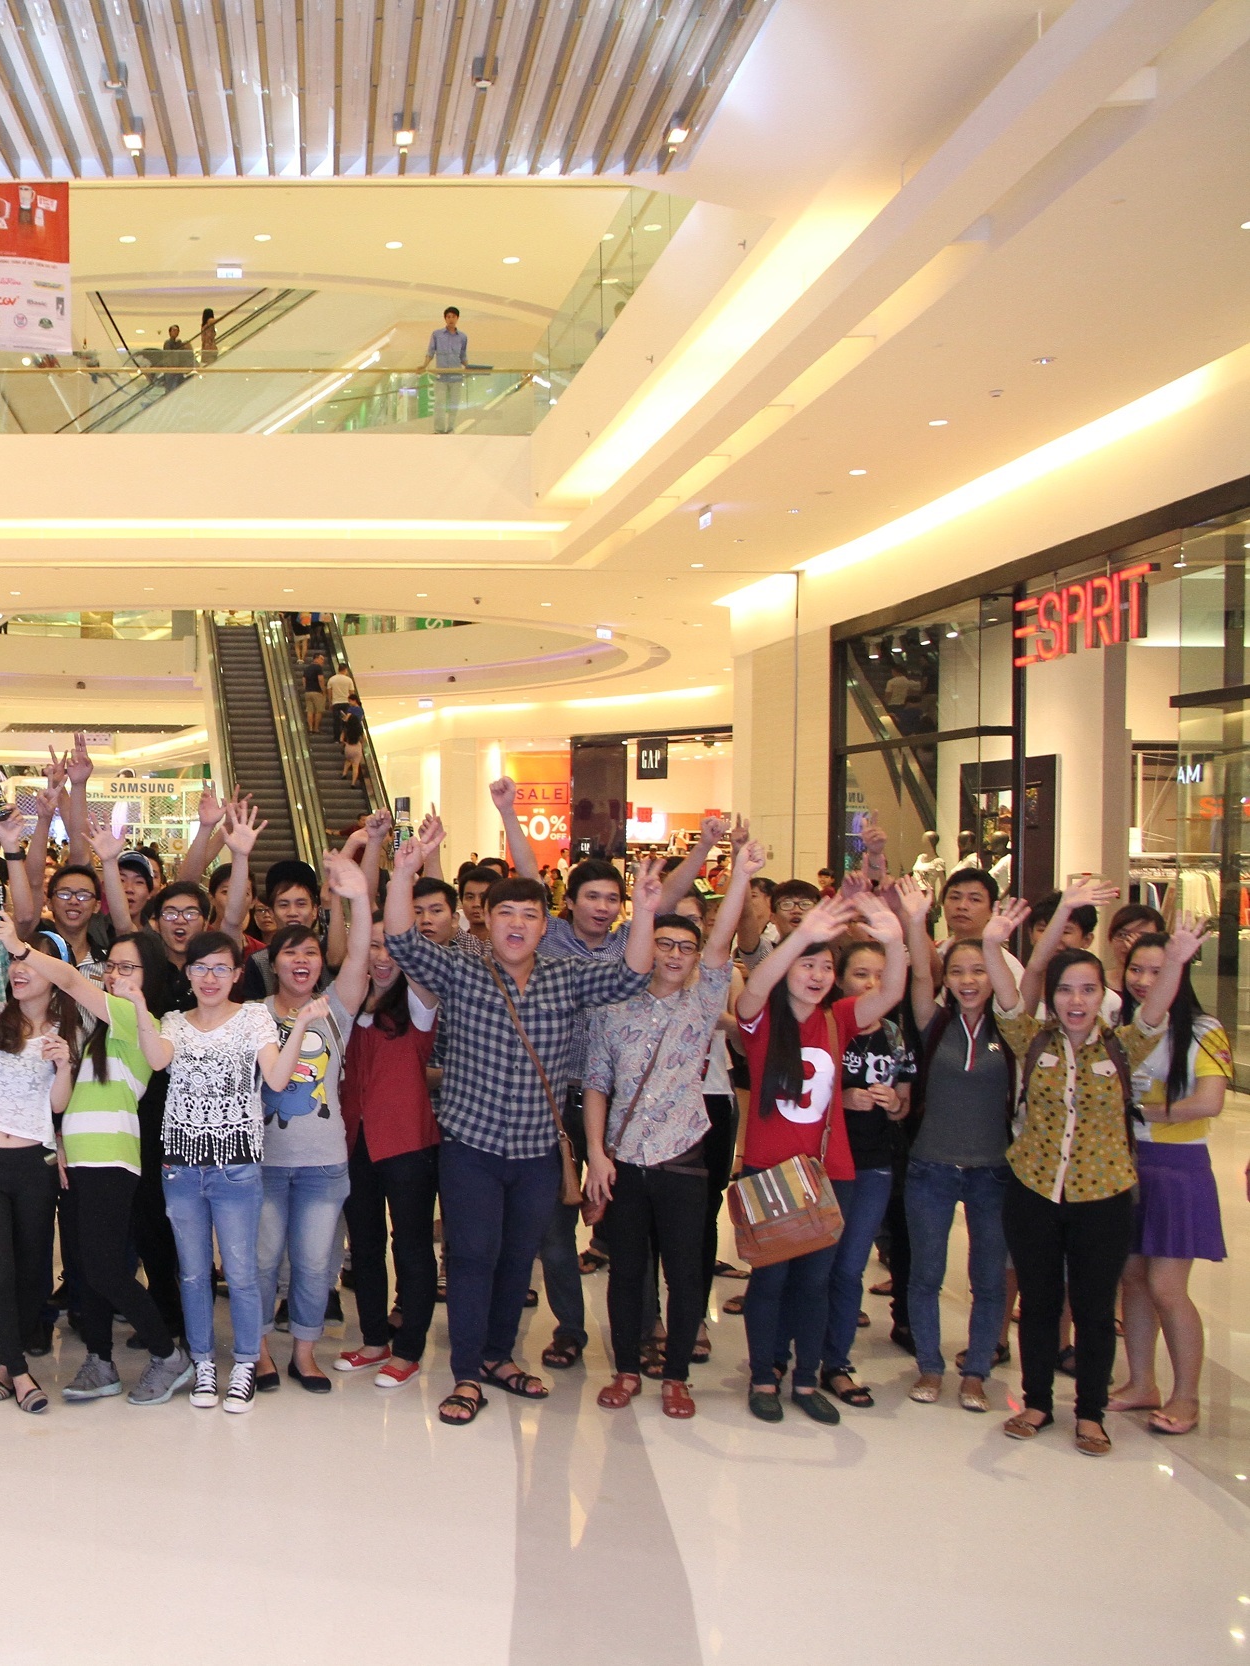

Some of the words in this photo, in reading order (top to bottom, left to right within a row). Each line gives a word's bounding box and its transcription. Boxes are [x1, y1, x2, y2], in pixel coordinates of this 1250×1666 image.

[1014, 562, 1153, 668] ESPRIT
[641, 750, 661, 769] GAP
[110, 782, 175, 794] SAMSUNG
[516, 788, 563, 800] SALE
[580, 842, 591, 852] GAP
